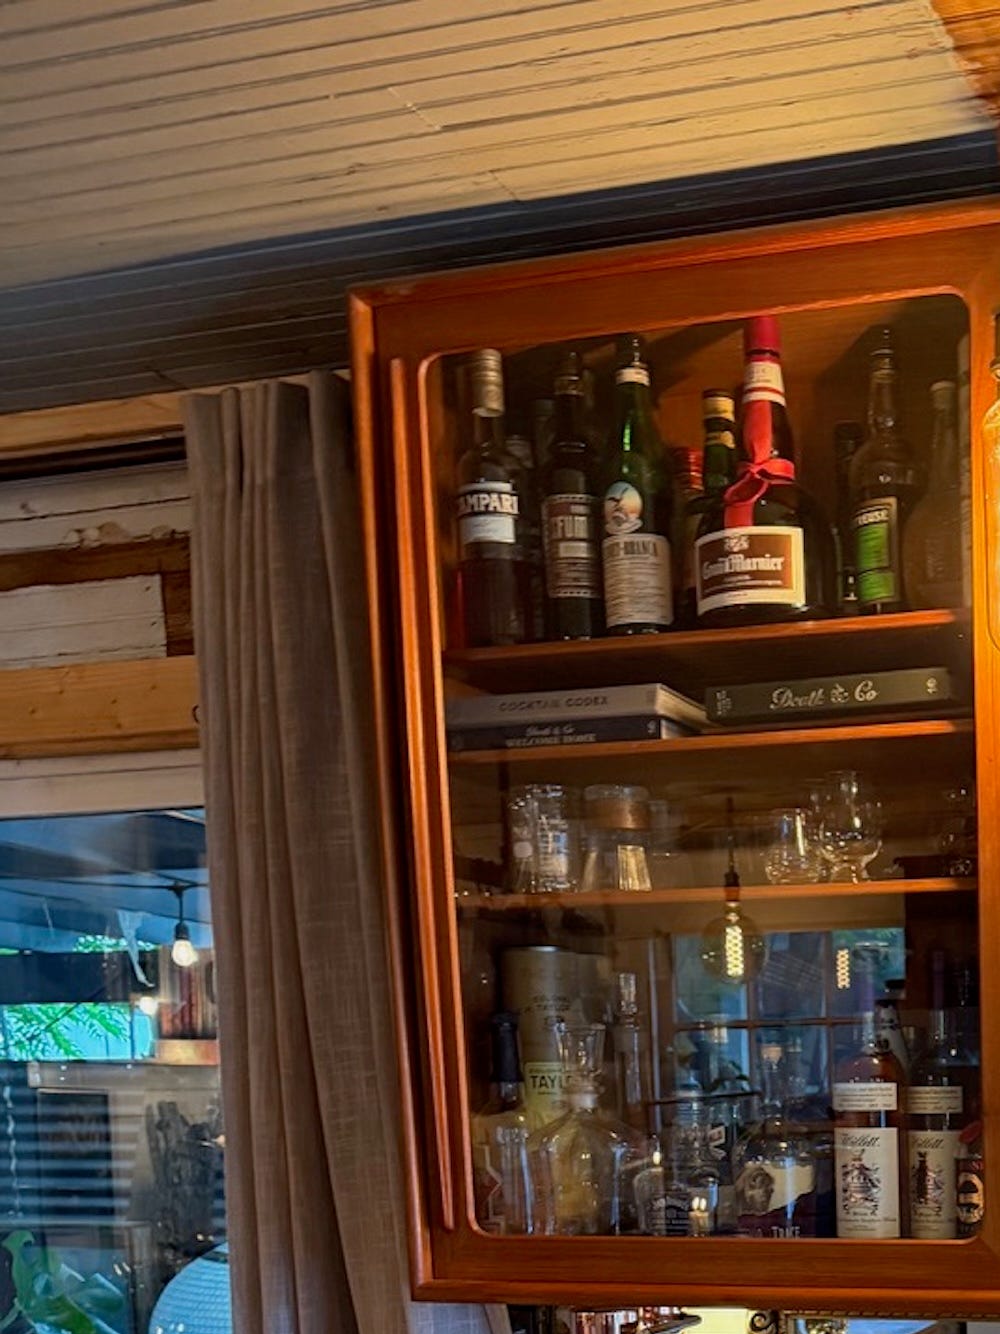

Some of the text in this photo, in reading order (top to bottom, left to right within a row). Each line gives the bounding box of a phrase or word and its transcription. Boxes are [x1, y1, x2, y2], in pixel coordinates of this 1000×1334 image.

[727, 554, 785, 573] Marnier
[830, 684, 849, 703] &
[854, 680, 879, 702] Co
[565, 695, 609, 708] CODEX
